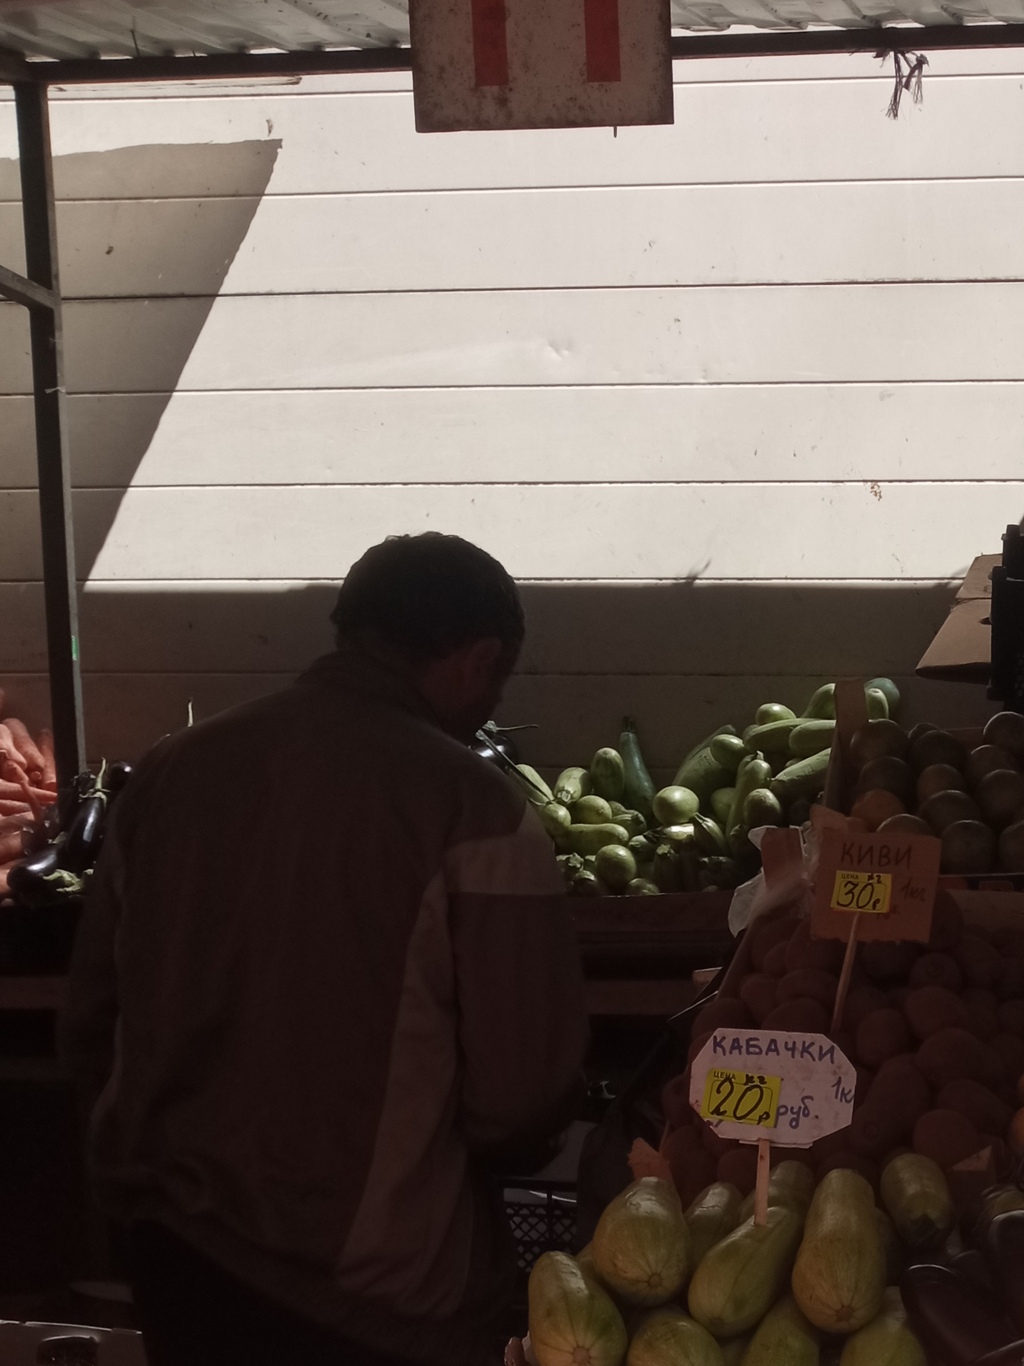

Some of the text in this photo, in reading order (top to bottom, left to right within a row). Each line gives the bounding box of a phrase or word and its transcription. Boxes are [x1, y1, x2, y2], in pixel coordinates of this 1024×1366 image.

[841, 841, 912, 869] КИВИ
[713, 1035, 836, 1064] КАБАЧКИ
[713, 1070, 736, 1080] ЦЕНА
